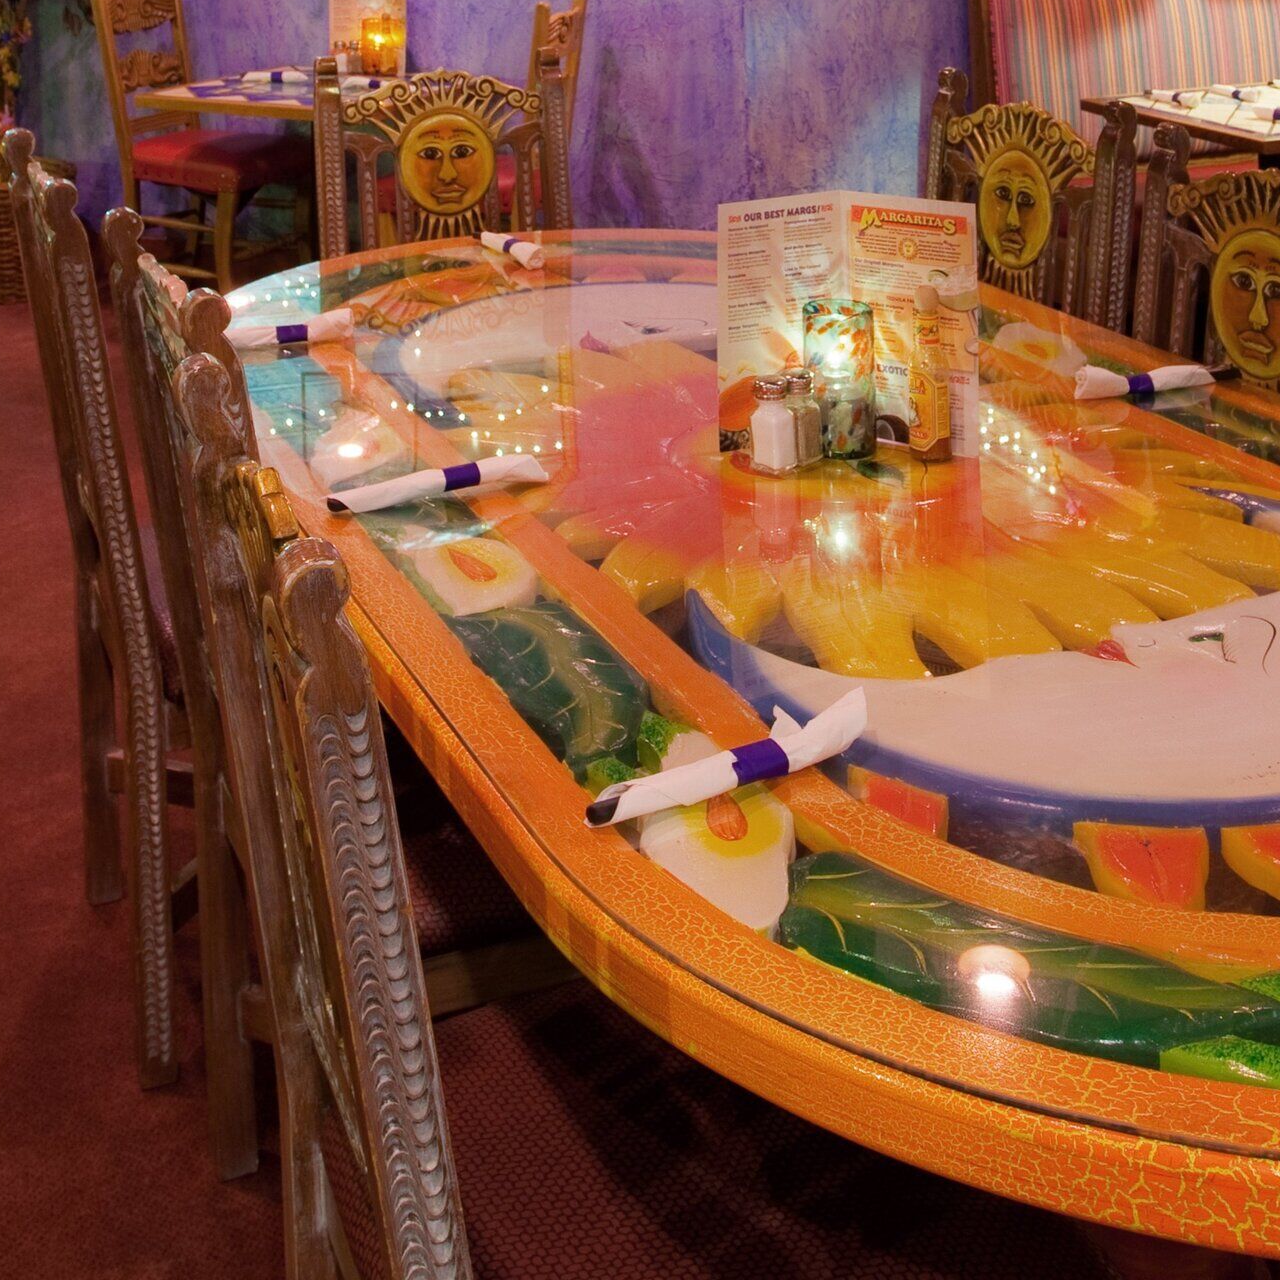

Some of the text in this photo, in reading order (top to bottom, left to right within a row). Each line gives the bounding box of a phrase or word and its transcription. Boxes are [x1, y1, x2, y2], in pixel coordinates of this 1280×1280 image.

[744, 205, 820, 222] OUR BEST MARGS!
[860, 207, 957, 236] MARGARITAS
[876, 363, 909, 377] EXOTIC
